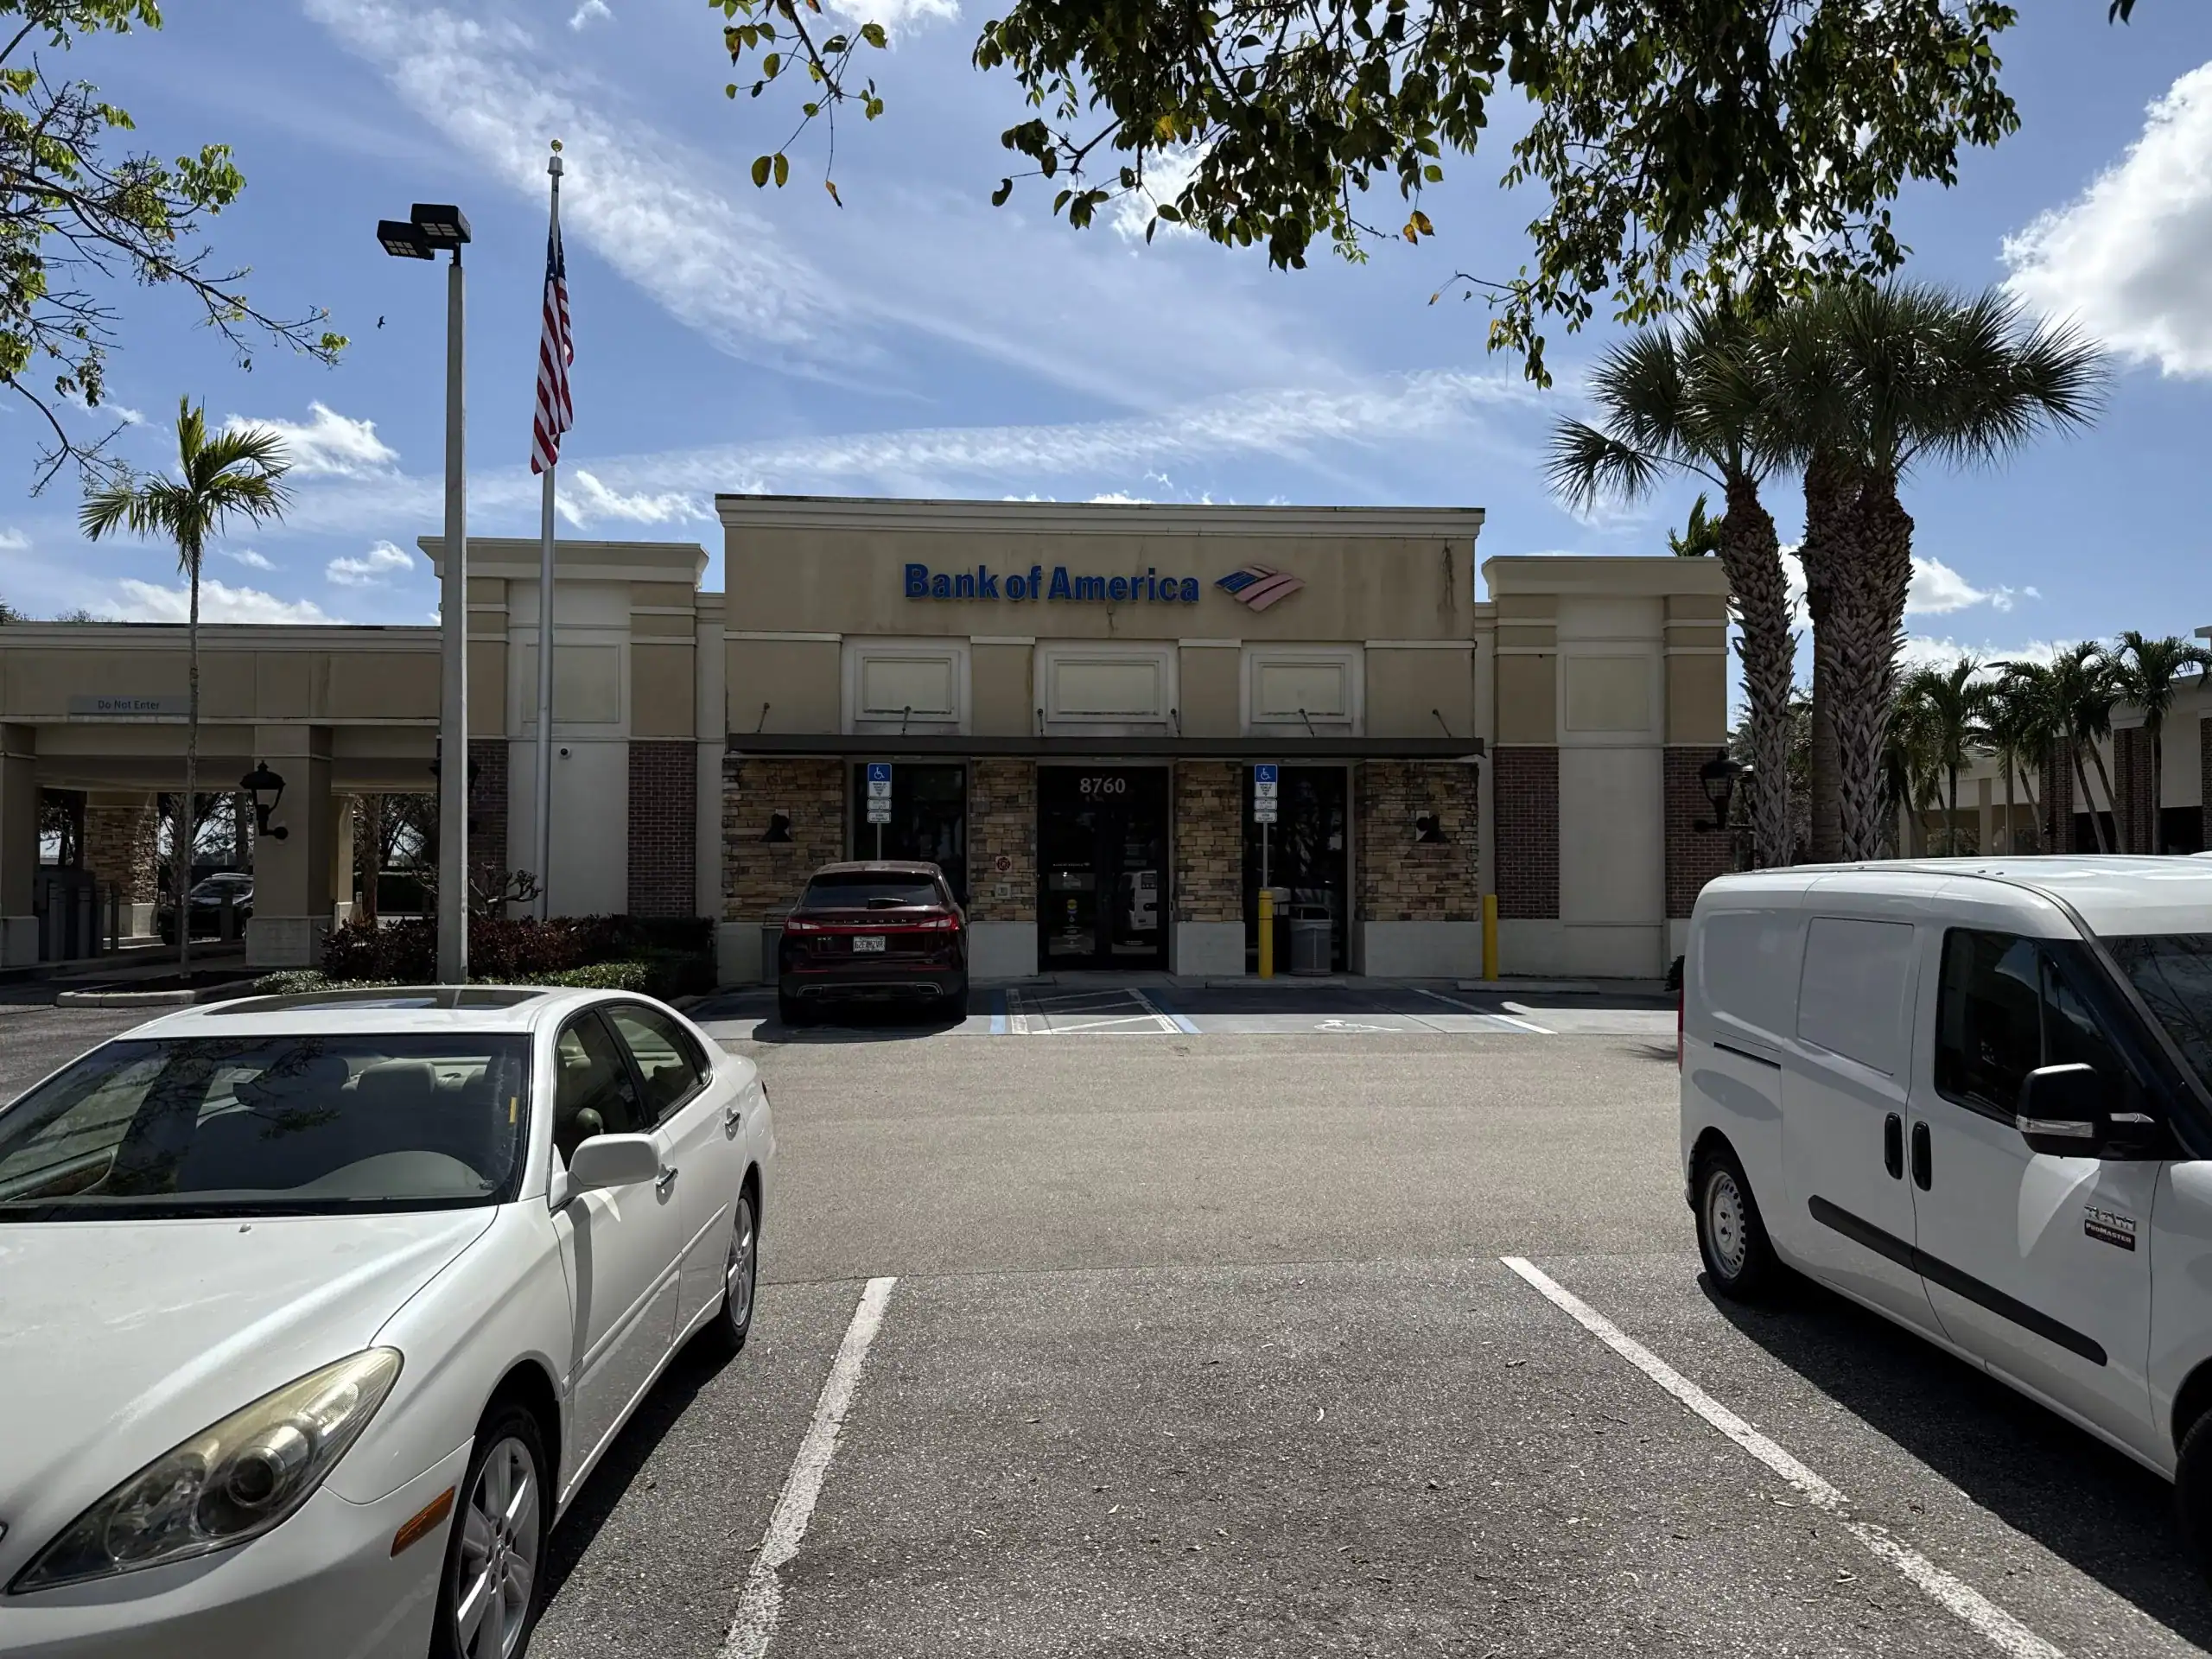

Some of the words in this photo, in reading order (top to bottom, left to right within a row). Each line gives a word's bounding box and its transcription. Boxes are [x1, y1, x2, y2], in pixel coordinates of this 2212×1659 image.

[905, 563, 1000, 600] Bank
[1005, 565, 1042, 601] of
[1047, 566, 1199, 601] America
[98, 700, 111, 709] Do
[114, 699, 131, 709] Not
[134, 700, 160, 709] Enter
[1079, 777, 1126, 793] 8760
[2084, 1205, 2136, 1232] RAM
